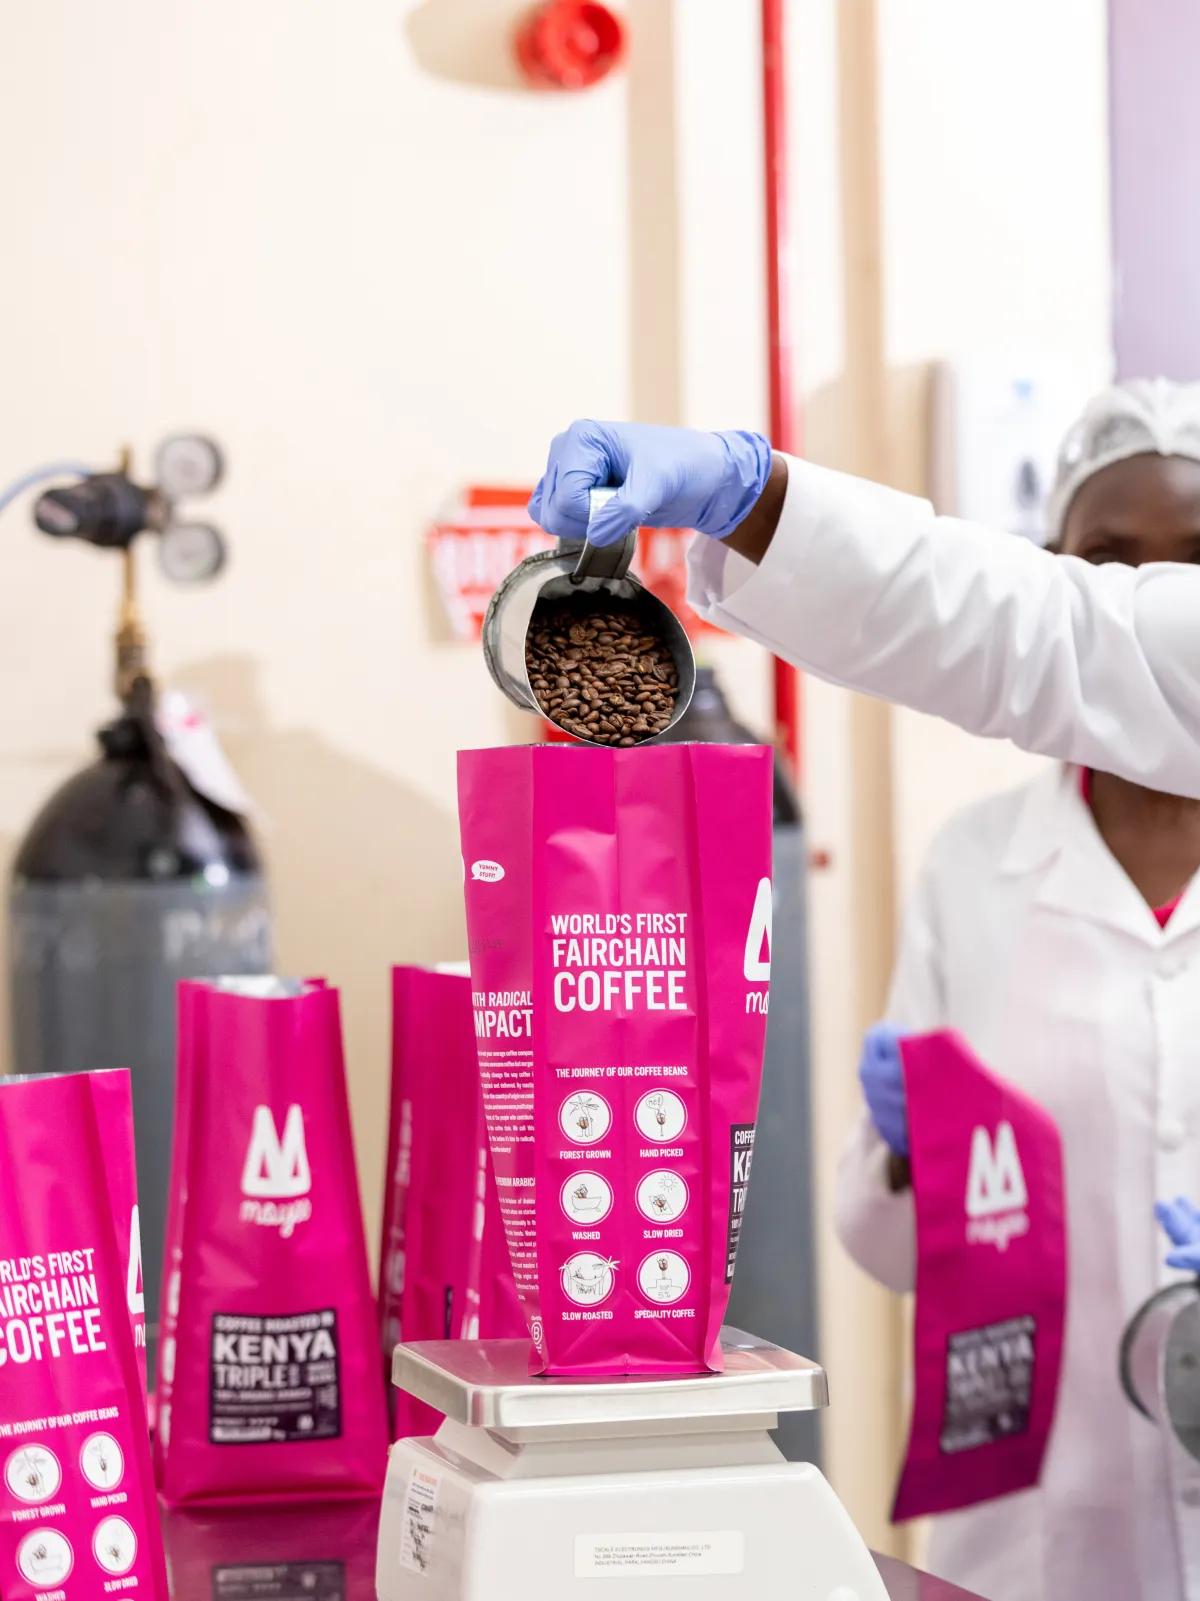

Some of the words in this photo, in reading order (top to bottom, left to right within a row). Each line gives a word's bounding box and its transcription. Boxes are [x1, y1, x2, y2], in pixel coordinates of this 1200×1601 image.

[551, 914, 632, 935] WORLD'S
[637, 913, 688, 934] FIRST
[552, 938, 686, 967] FAIRCHAIN
[488, 990, 533, 1007] RADICAL
[554, 970, 688, 1012] COFFEE
[556, 1069, 570, 1078] THE
[571, 1067, 604, 1078] JOURNEY
[606, 1067, 617, 1077] OF
[617, 1067, 633, 1077] OUR
[634, 1066, 662, 1076] COFFEE
[663, 1066, 688, 1076] BEANS
[560, 1150, 585, 1159] FOREST
[585, 1150, 612, 1159] GROWN
[640, 1149, 659, 1158] HAND
[660, 1148, 684, 1157] PICKED
[572, 1231, 600, 1240] WASHED
[643, 1230, 663, 1239] SLOW
[664, 1229, 684, 1238] DRIED
[47, 1248, 95, 1276] FIRST
[562, 1311, 581, 1321] SLOW
[582, 1311, 613, 1320] ROASTED
[634, 1309, 672, 1319] SPECIALITY
[671, 1309, 696, 1318] COFFEE
[214, 1329, 337, 1364] KENYA
[214, 1364, 288, 1389] TRIPLE
[13, 1417, 48, 1435] JOURNEY
[48, 1415, 58, 1429] OF
[56, 1413, 73, 1428] OUR
[73, 1408, 99, 1424] COFFEE
[98, 1406, 119, 1421] BEANS
[90, 1496, 109, 1509] HAND
[108, 1492, 128, 1505] PICKED
[12, 1508, 40, 1522] FOREST
[39, 1503, 66, 1518] GROWN
[103, 1580, 122, 1593] SLOW
